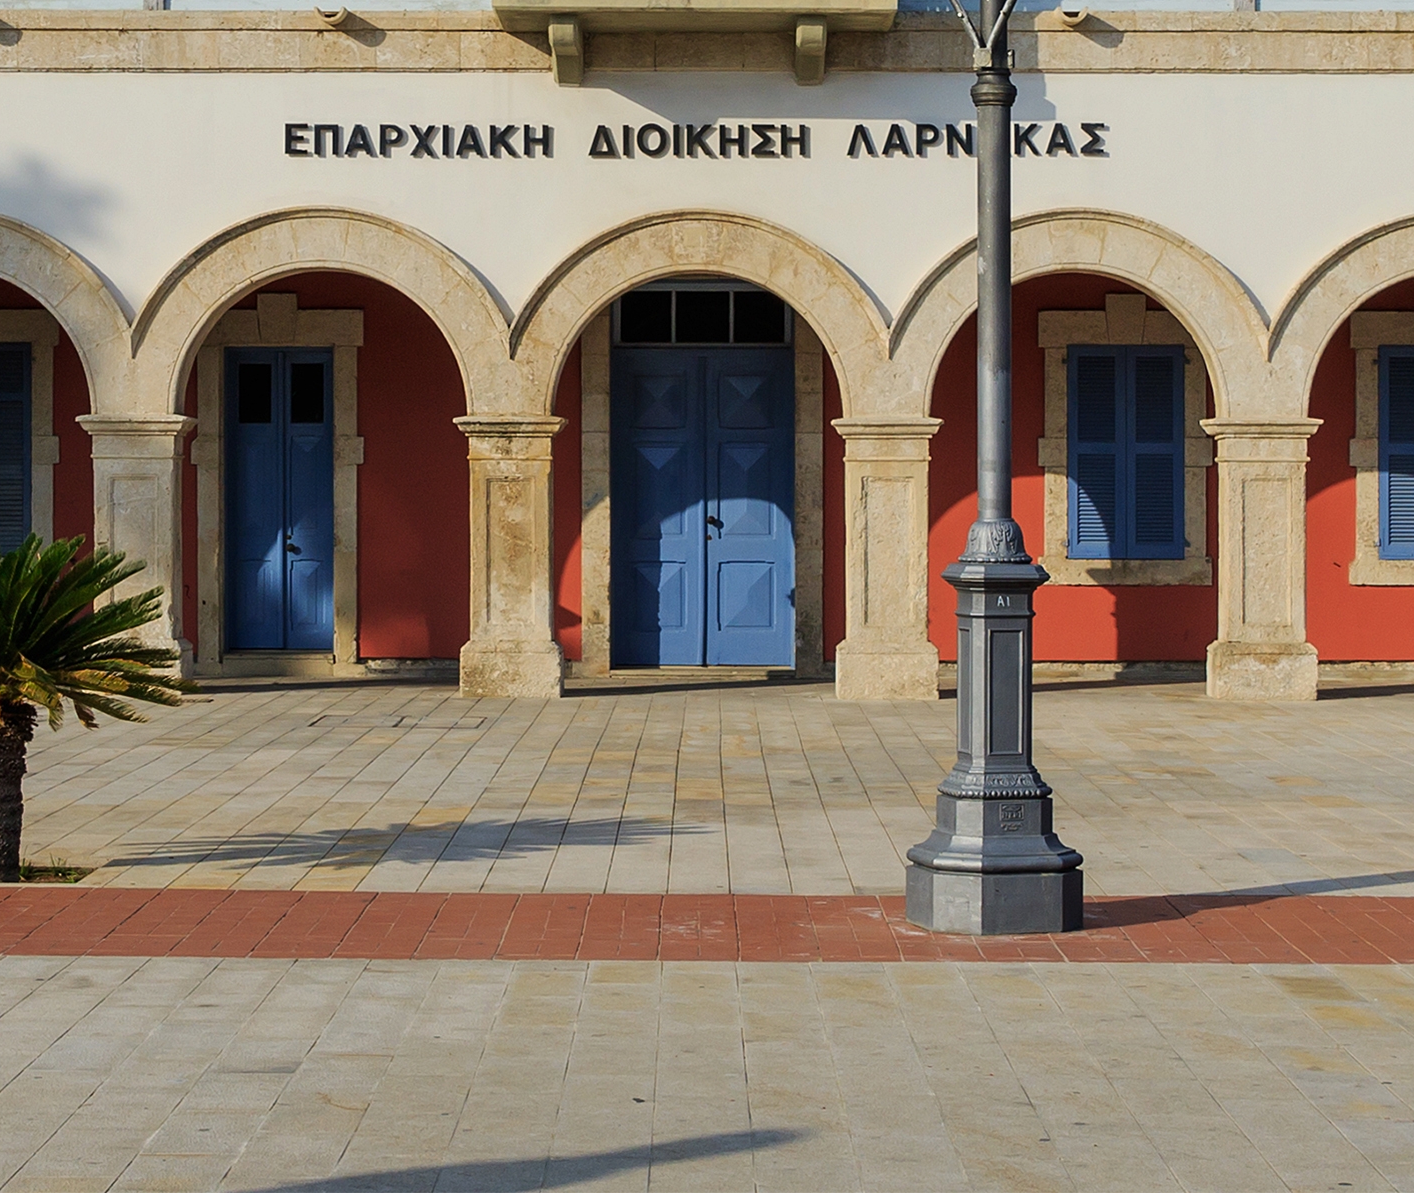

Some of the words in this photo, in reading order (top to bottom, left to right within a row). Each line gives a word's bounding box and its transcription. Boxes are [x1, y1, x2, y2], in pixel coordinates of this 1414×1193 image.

[284, 123, 551, 157] ΕΠΑΡΧΙΑΚΗ
[587, 122, 807, 157] ΔΙΟΙΚΗΣΗ
[846, 122, 1106, 157] ΛΑΡΝΚΑΣ
